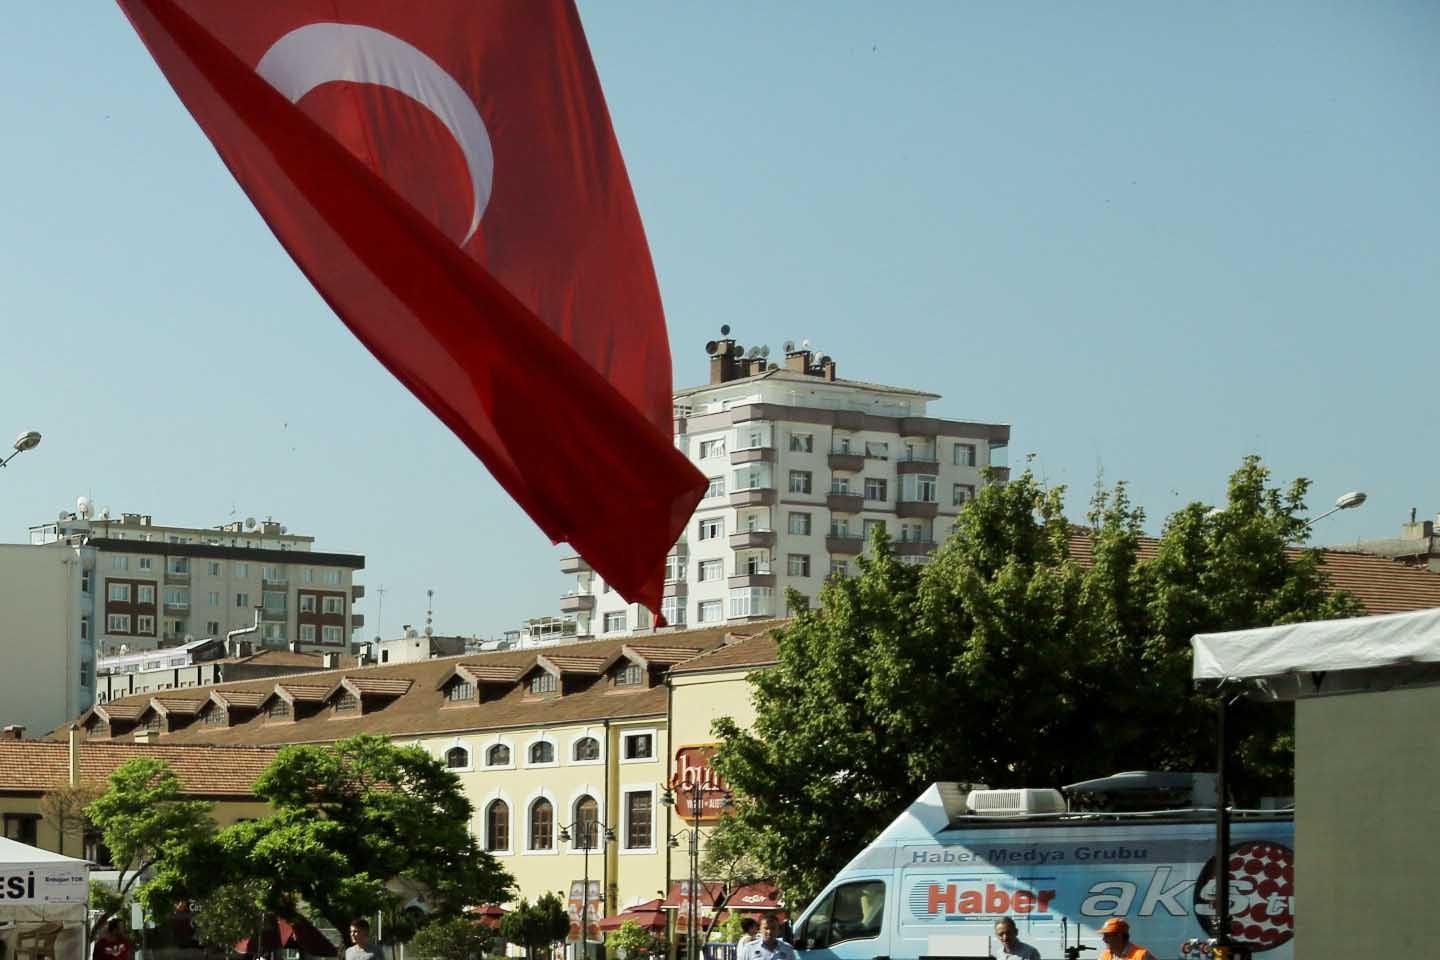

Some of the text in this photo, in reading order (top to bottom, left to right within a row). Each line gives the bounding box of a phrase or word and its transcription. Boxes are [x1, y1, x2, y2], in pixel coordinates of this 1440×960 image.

[912, 846, 1148, 864] Haber Medya Grubu
[928, 884, 1056, 914] Haber
